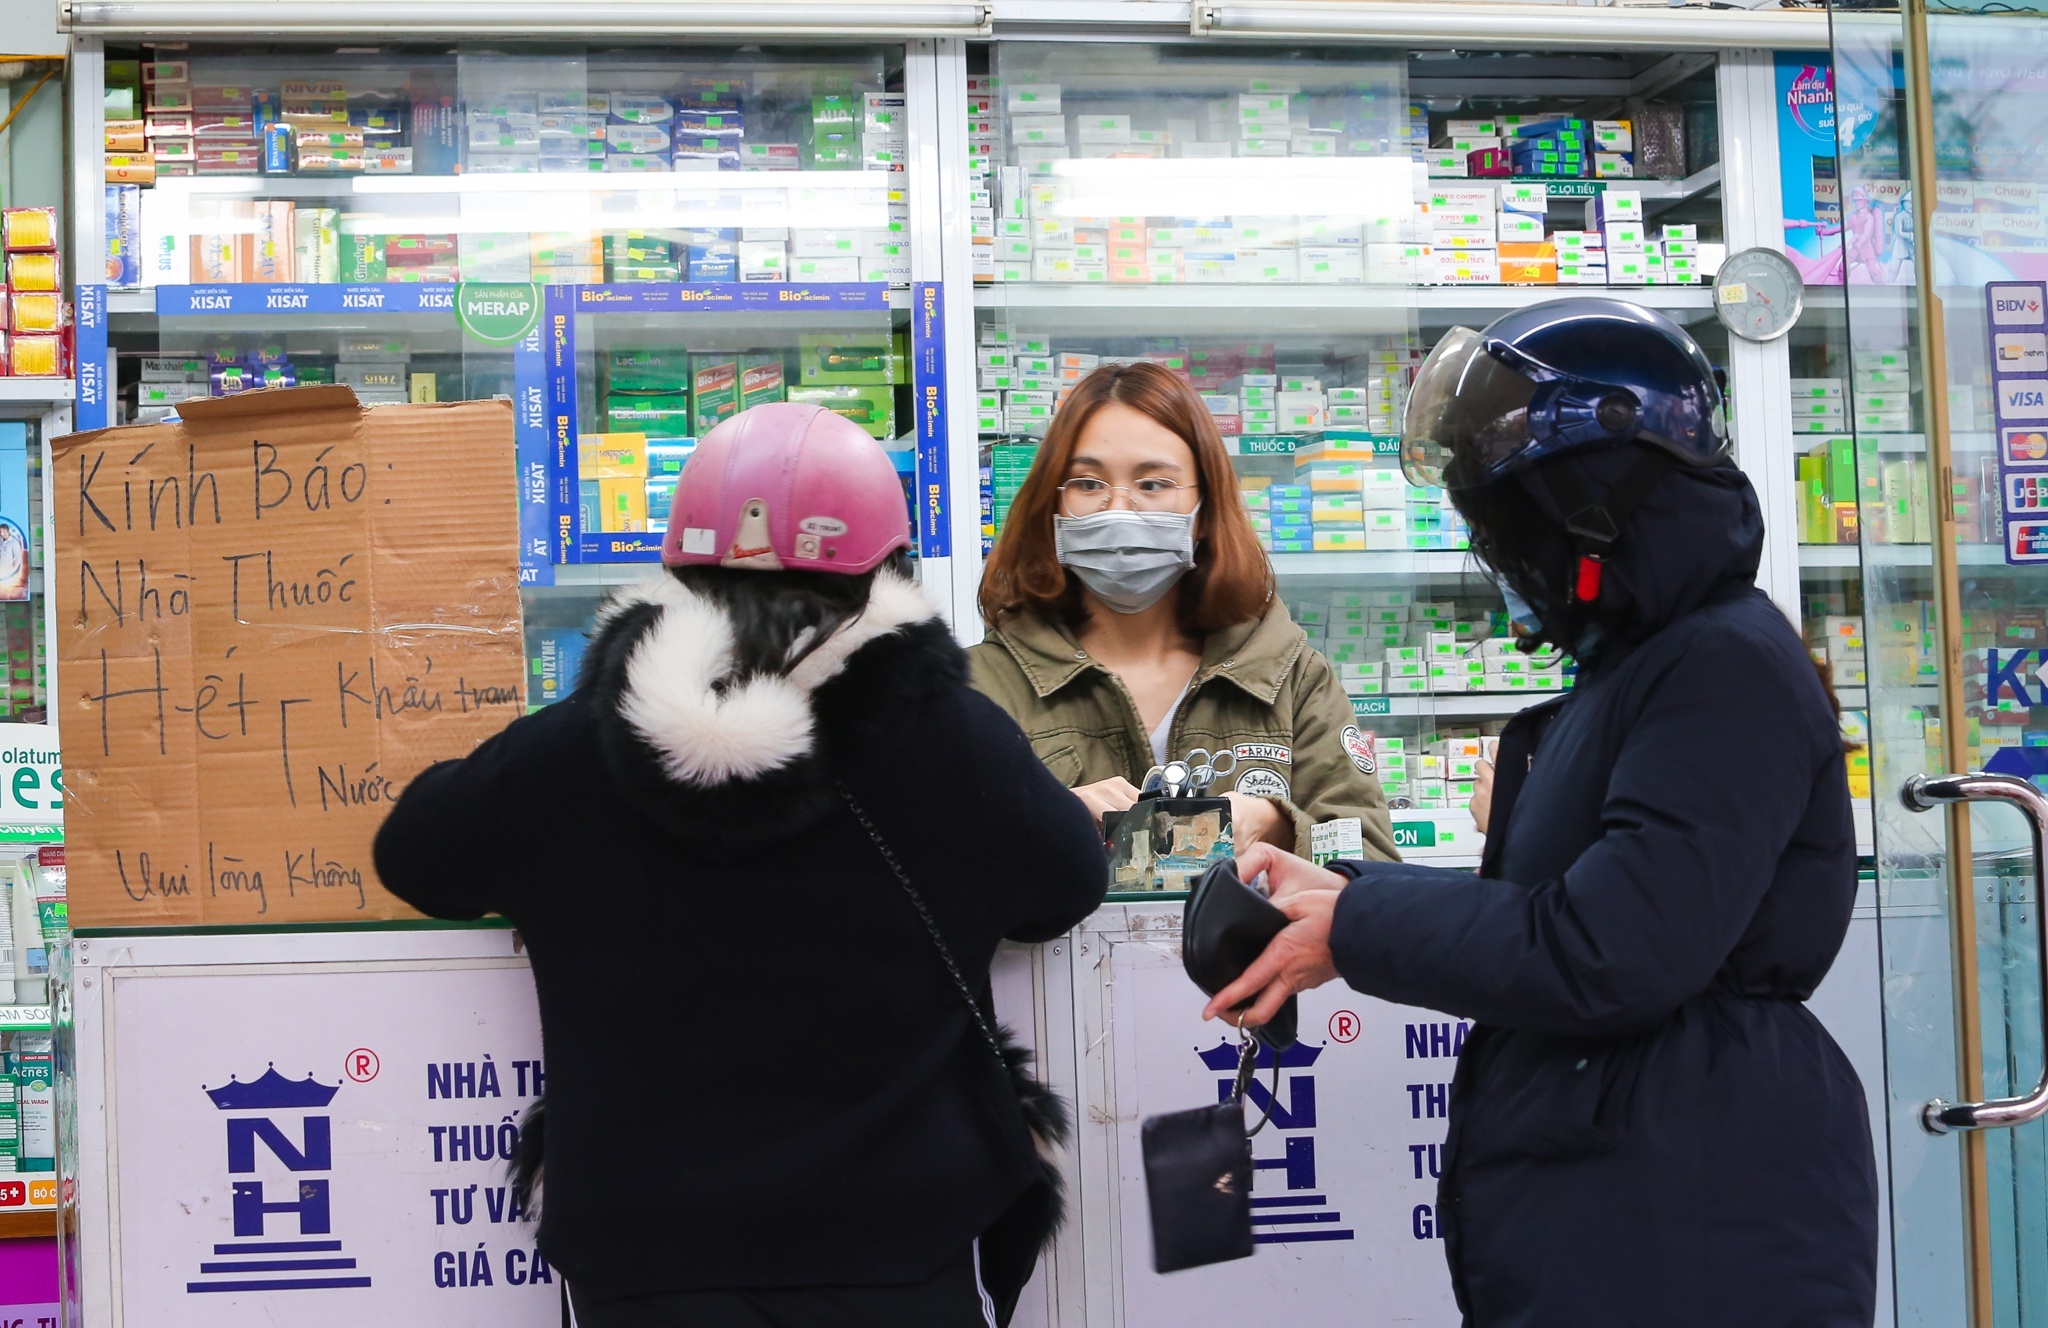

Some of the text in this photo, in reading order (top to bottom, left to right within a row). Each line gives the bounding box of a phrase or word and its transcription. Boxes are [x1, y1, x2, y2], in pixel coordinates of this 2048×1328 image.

[1787, 88, 1834, 105] Nhanh
[1824, 103, 1846, 114] Hiu
[1839, 116, 1856, 147] 4
[1559, 185, 1575, 196] LỢI
[1813, 184, 1836, 195] oay
[1863, 183, 1901, 195] Choay
[1994, 185, 2032, 197] Choay
[2002, 217, 2041, 230] Choay
[81, 286, 95, 328] XISAT
[190, 296, 233, 310] XISAT
[266, 295, 309, 309] XISAT
[342, 294, 385, 308] XISAT
[418, 294, 454, 308] XISA
[467, 301, 531, 317] MERAP
[1996, 299, 2027, 312] BIDV
[526, 324, 540, 353] XIS
[82, 363, 96, 404] XISAT
[364, 374, 389, 385] PLUS
[528, 386, 543, 428] XISAT
[2008, 392, 2045, 407] VISA
[1249, 438, 1285, 452] THUỐC
[79, 442, 220, 536] Kính
[531, 461, 546, 505] XISAT
[2014, 486, 2048, 499] JCB
[80, 549, 356, 629] Nhà Thuốc
[338, 656, 443, 728] Khẩu
[1352, 702, 1386, 714] MẠCH
[1248, 746, 1279, 758] ARMY
[0, 766, 64, 810] es
[318, 760, 400, 811] Nước
[1244, 774, 1284, 791] Shelter
[208, 841, 267, 915] lòng
[285, 847, 366, 910] Không
[11, 1066, 49, 1078] Acnes
[427, 1054, 501, 1100] NHÀ
[1406, 1082, 1453, 1119] TH
[428, 1110, 520, 1163] THUỐ
[33, 1187, 47, 1200] BỘ
[430, 1183, 479, 1226] TƯ
[434, 1242, 494, 1289] GIÁ
